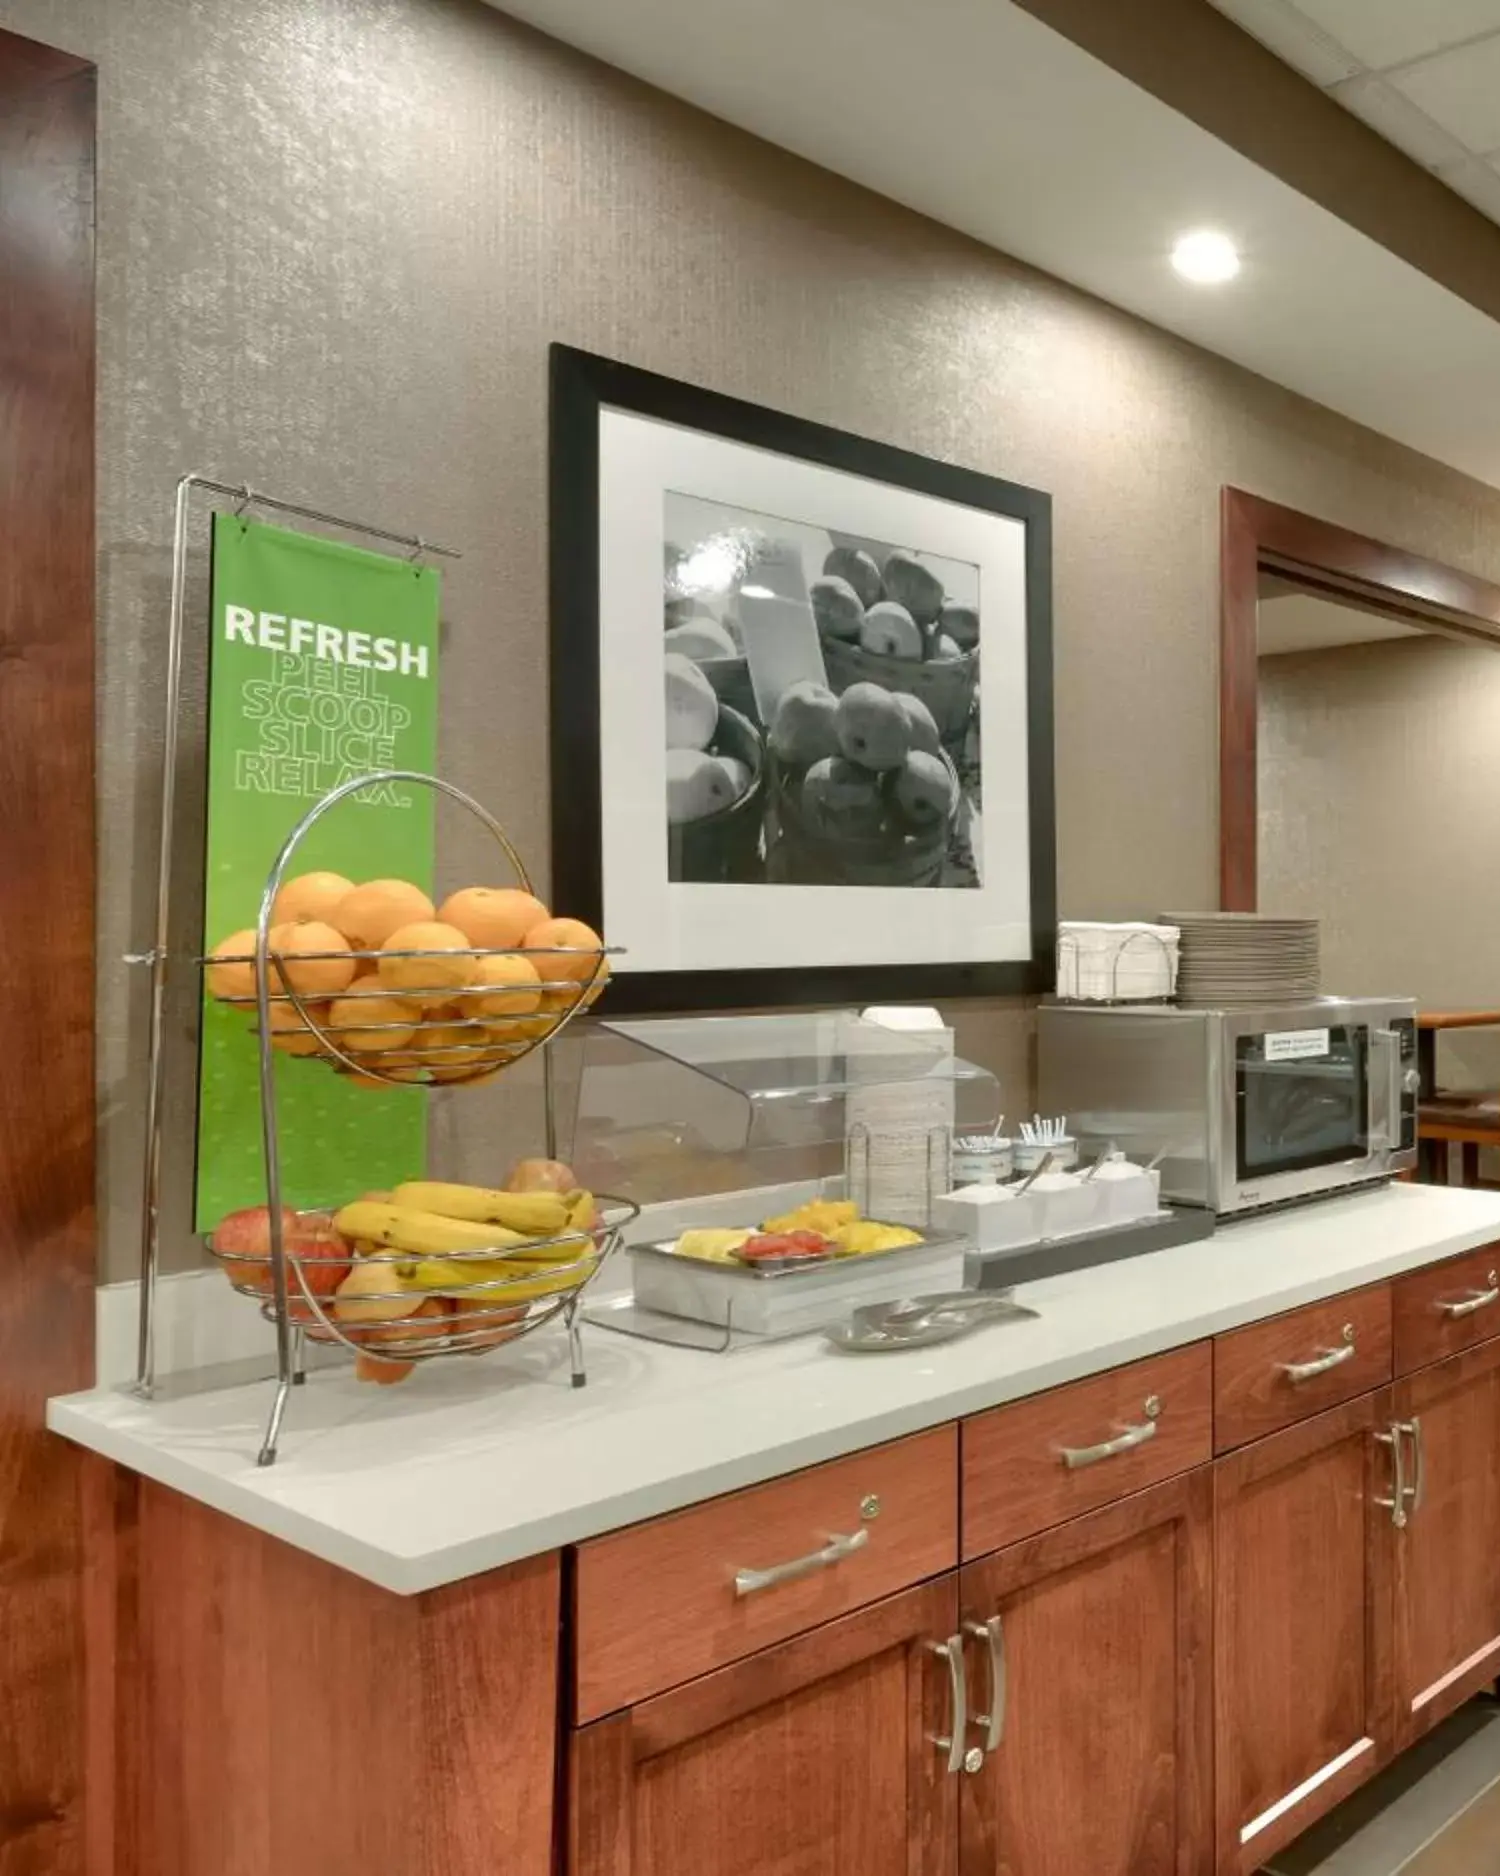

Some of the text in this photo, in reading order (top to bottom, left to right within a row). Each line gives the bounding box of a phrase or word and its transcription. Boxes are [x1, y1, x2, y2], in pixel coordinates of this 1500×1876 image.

[225, 604, 429, 678] REFRESH
[272, 649, 388, 703] PEEL
[242, 679, 411, 737] SCOOP
[259, 718, 395, 773] SLICE
